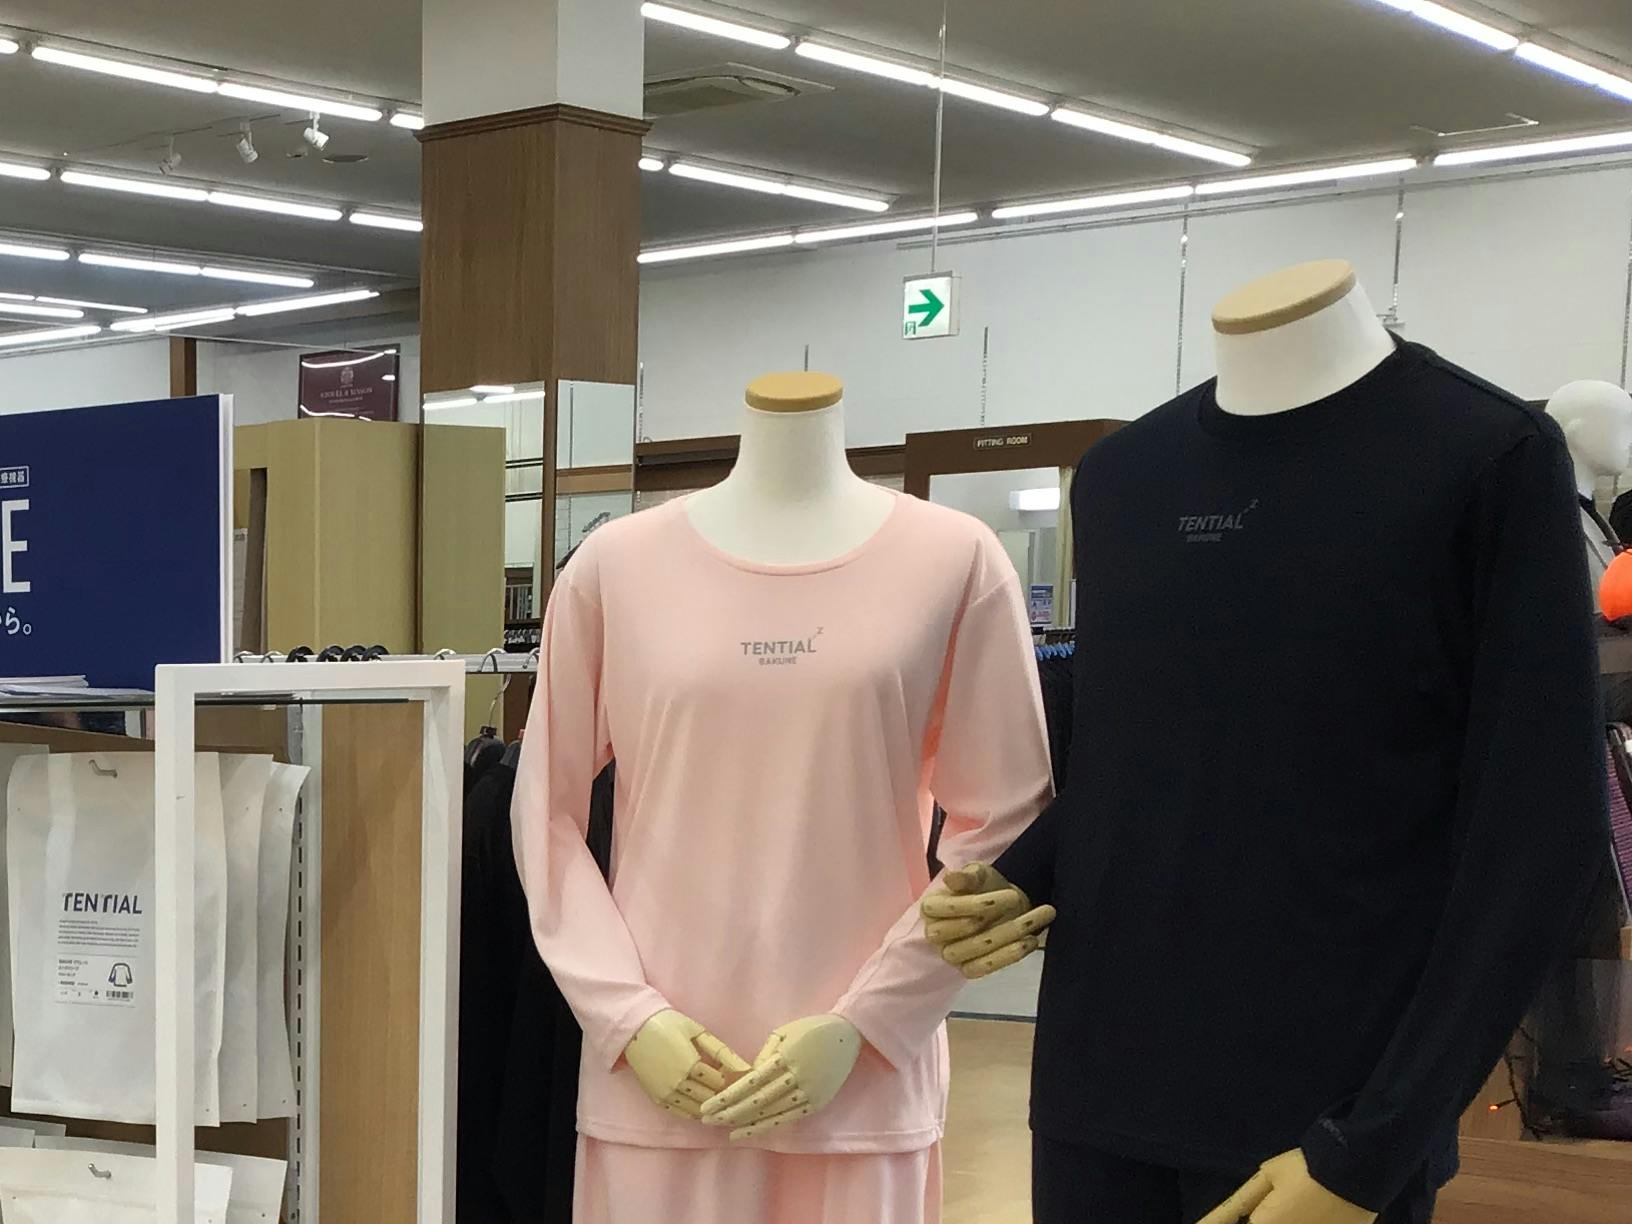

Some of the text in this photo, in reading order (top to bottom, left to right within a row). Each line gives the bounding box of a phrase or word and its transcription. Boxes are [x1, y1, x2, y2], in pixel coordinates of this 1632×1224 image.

[1178, 513, 1244, 531] TENTIAL
[740, 638, 817, 655] TENTIAL
[63, 892, 143, 914] TENTIAL
